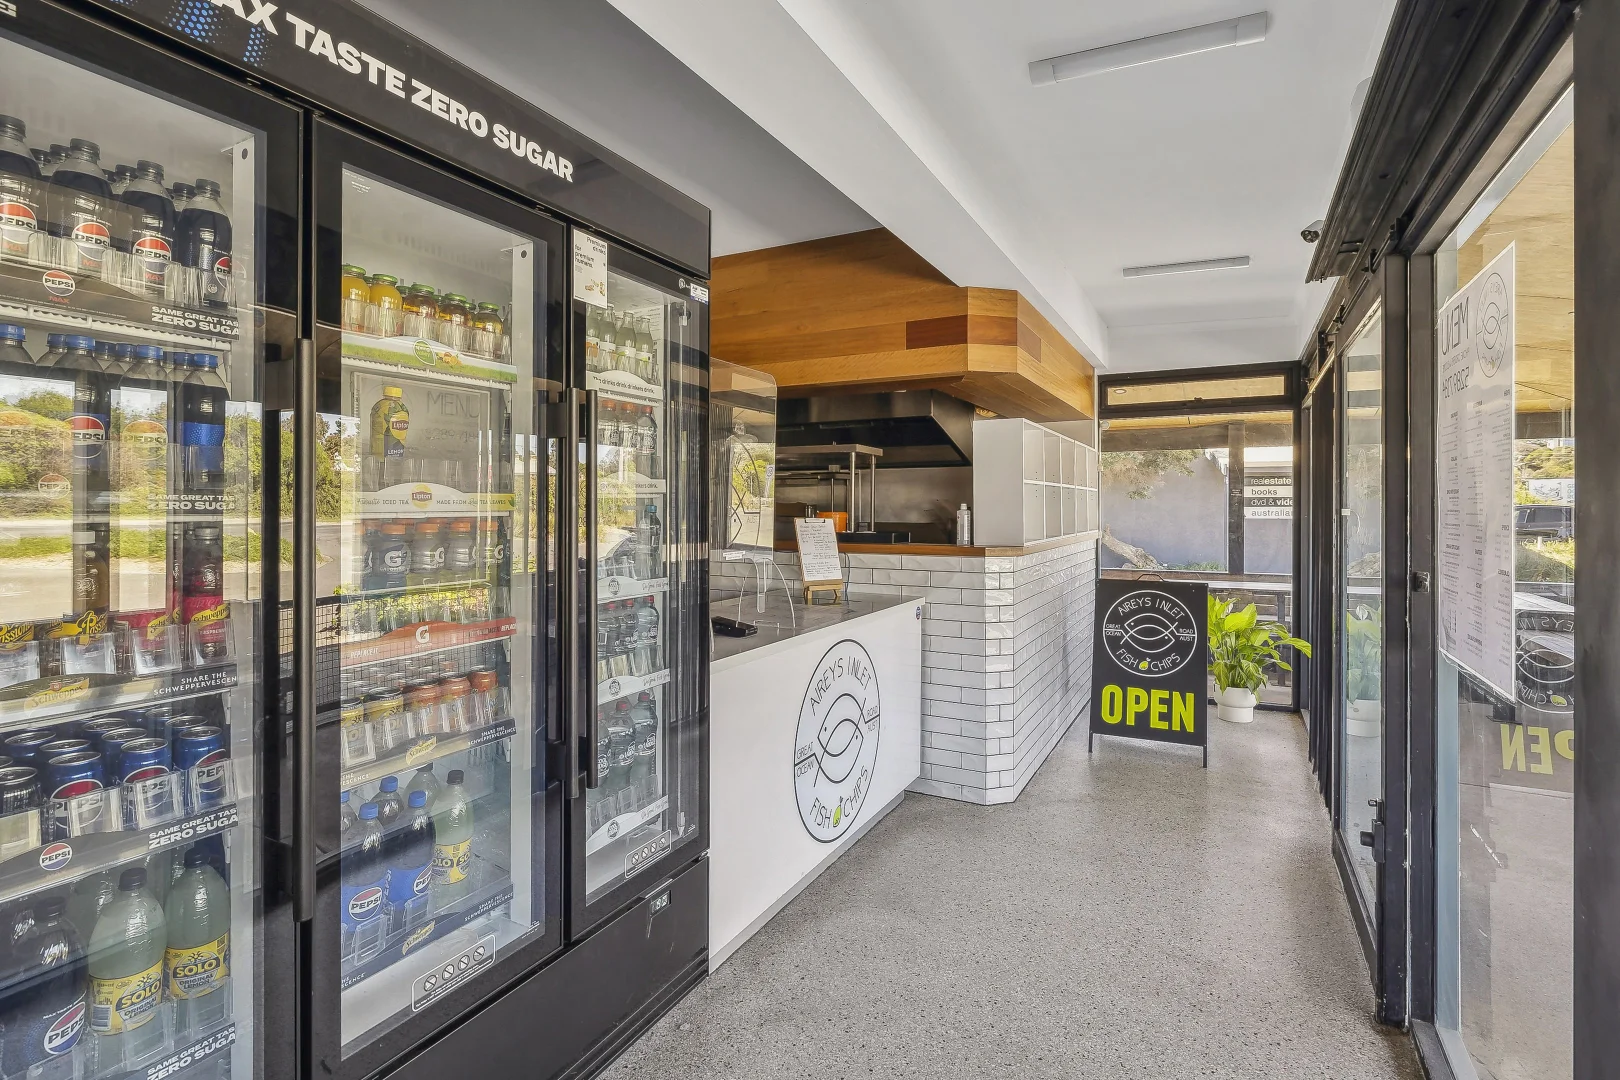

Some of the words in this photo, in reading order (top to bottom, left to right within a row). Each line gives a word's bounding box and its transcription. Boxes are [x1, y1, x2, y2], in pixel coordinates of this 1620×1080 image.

[285, 12, 405, 99] TASTE
[411, 78, 489, 138] ZERO
[493, 123, 574, 183] SUGAR
[44, 277, 74, 289] PEPSI
[151, 312, 197, 328] ZERO
[152, 306, 184, 317] SAME
[185, 312, 219, 324] GREAT
[413, 493, 431, 501] Lipton
[1251, 488, 1278, 496] books
[1250, 498, 1267, 506] dvd
[1268, 498, 1275, 506] &
[1117, 597, 1152, 616] AIREYS
[1155, 598, 1185, 619] INLET
[415, 625, 430, 643] G
[1116, 648, 1139, 668] FISH
[1150, 652, 1181, 671] CHIPS
[181, 674, 209, 685] SHARE
[211, 671, 227, 679] THE
[809, 657, 844, 716] AIREYS
[846, 655, 871, 692] INLET
[866, 704, 879, 717] ROAD
[1100, 684, 1196, 734] OPEN
[796, 741, 814, 760] GREAT
[796, 760, 815, 779] OCEAN
[809, 797, 832, 829] FISH
[843, 765, 869, 819] CHIPS
[149, 825, 179, 839] SAME
[181, 815, 217, 829] GREAT
[149, 830, 194, 849] ZERO
[41, 849, 71, 864] PEPSI
[350, 896, 381, 911] PEPSI
[175, 959, 217, 978] SOLO
[179, 973, 214, 986] ORIGINAL
[183, 979, 210, 990] LEMON
[121, 981, 161, 1009] SOLO
[147, 1055, 179, 1076] SAME
[180, 1036, 215, 1059] GREAT
